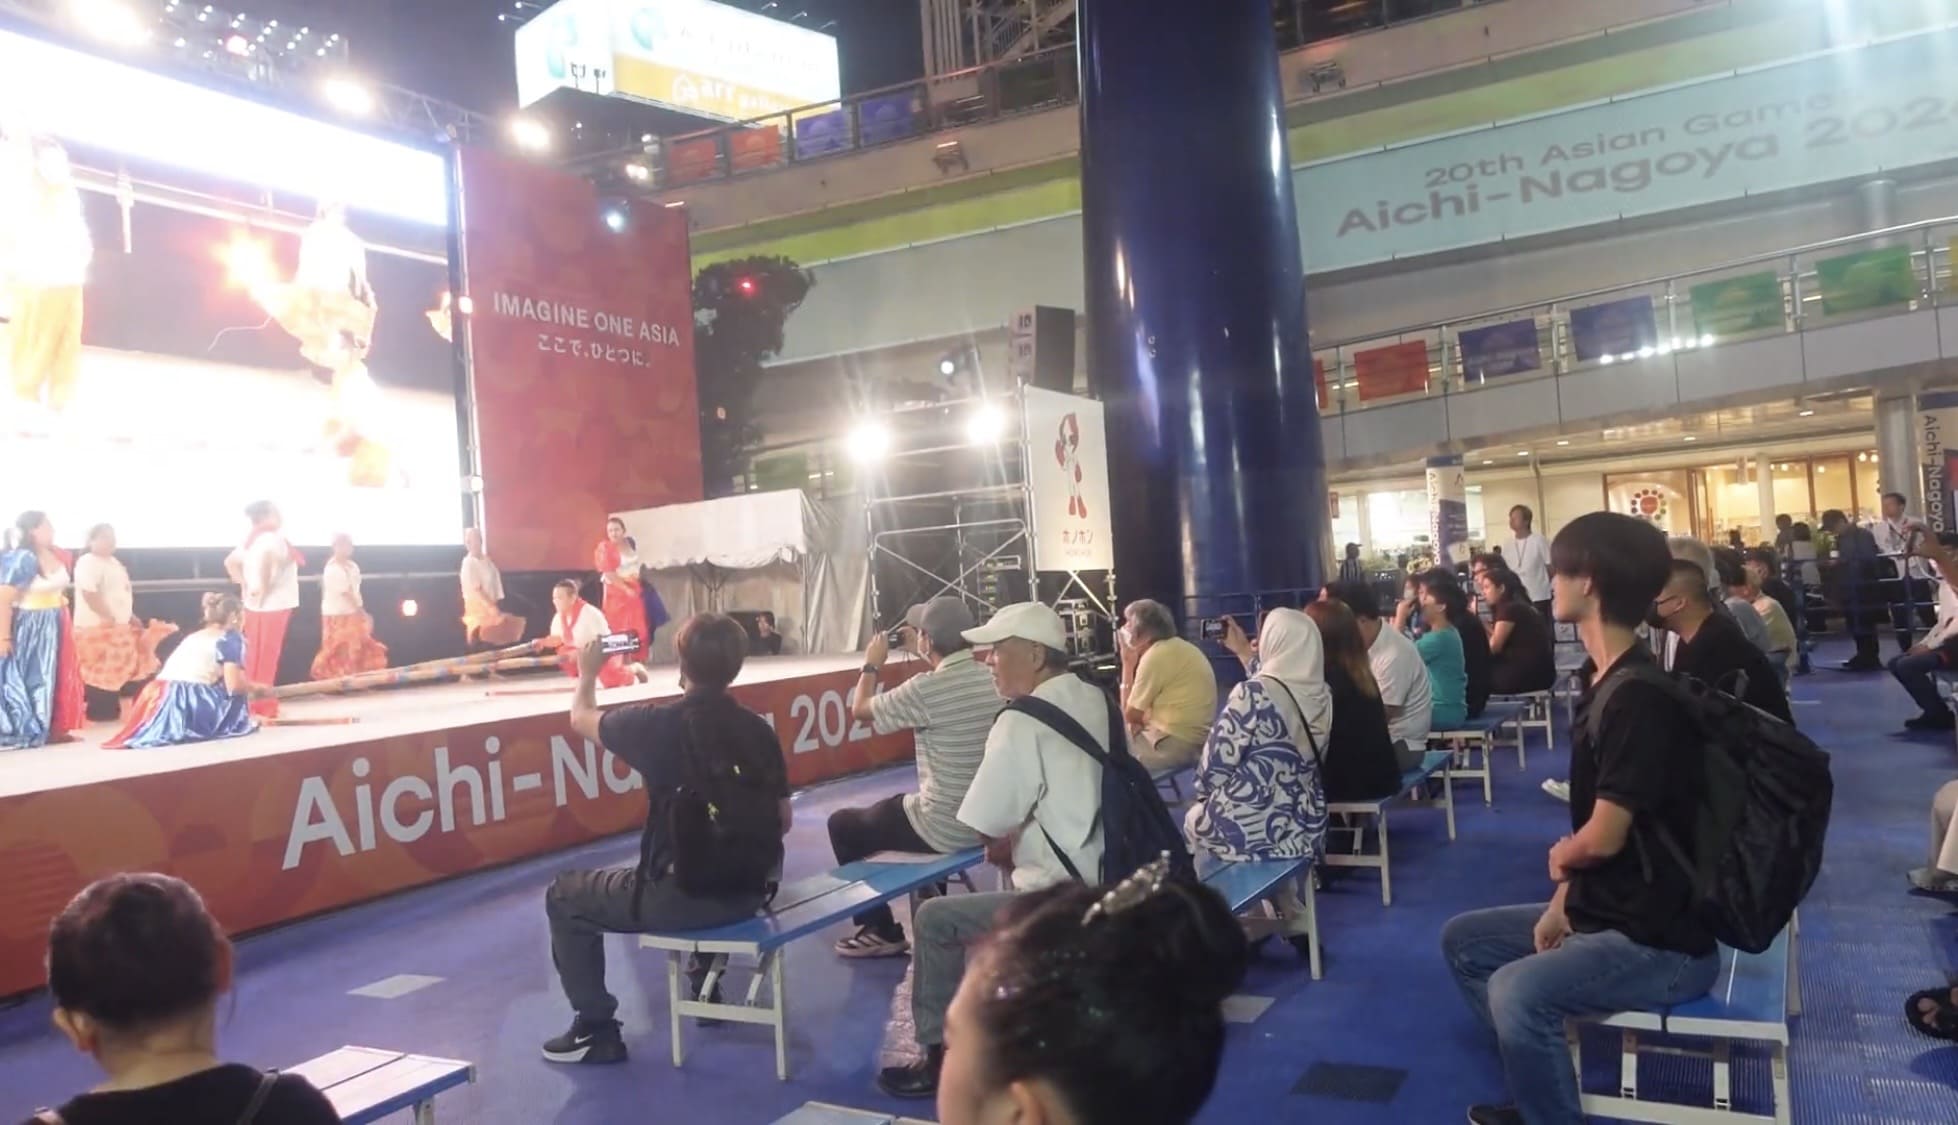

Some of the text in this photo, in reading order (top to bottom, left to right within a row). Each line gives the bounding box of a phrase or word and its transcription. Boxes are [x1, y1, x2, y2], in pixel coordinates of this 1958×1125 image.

[1336, 134, 1779, 238] Aichi-Nagoya
[1425, 91, 1850, 188] 20th Asian Game
[494, 292, 680, 347] IMAGINE ONE ASIA
[1925, 415, 1944, 533] Aichi-Nagoya
[791, 682, 887, 754] 202
